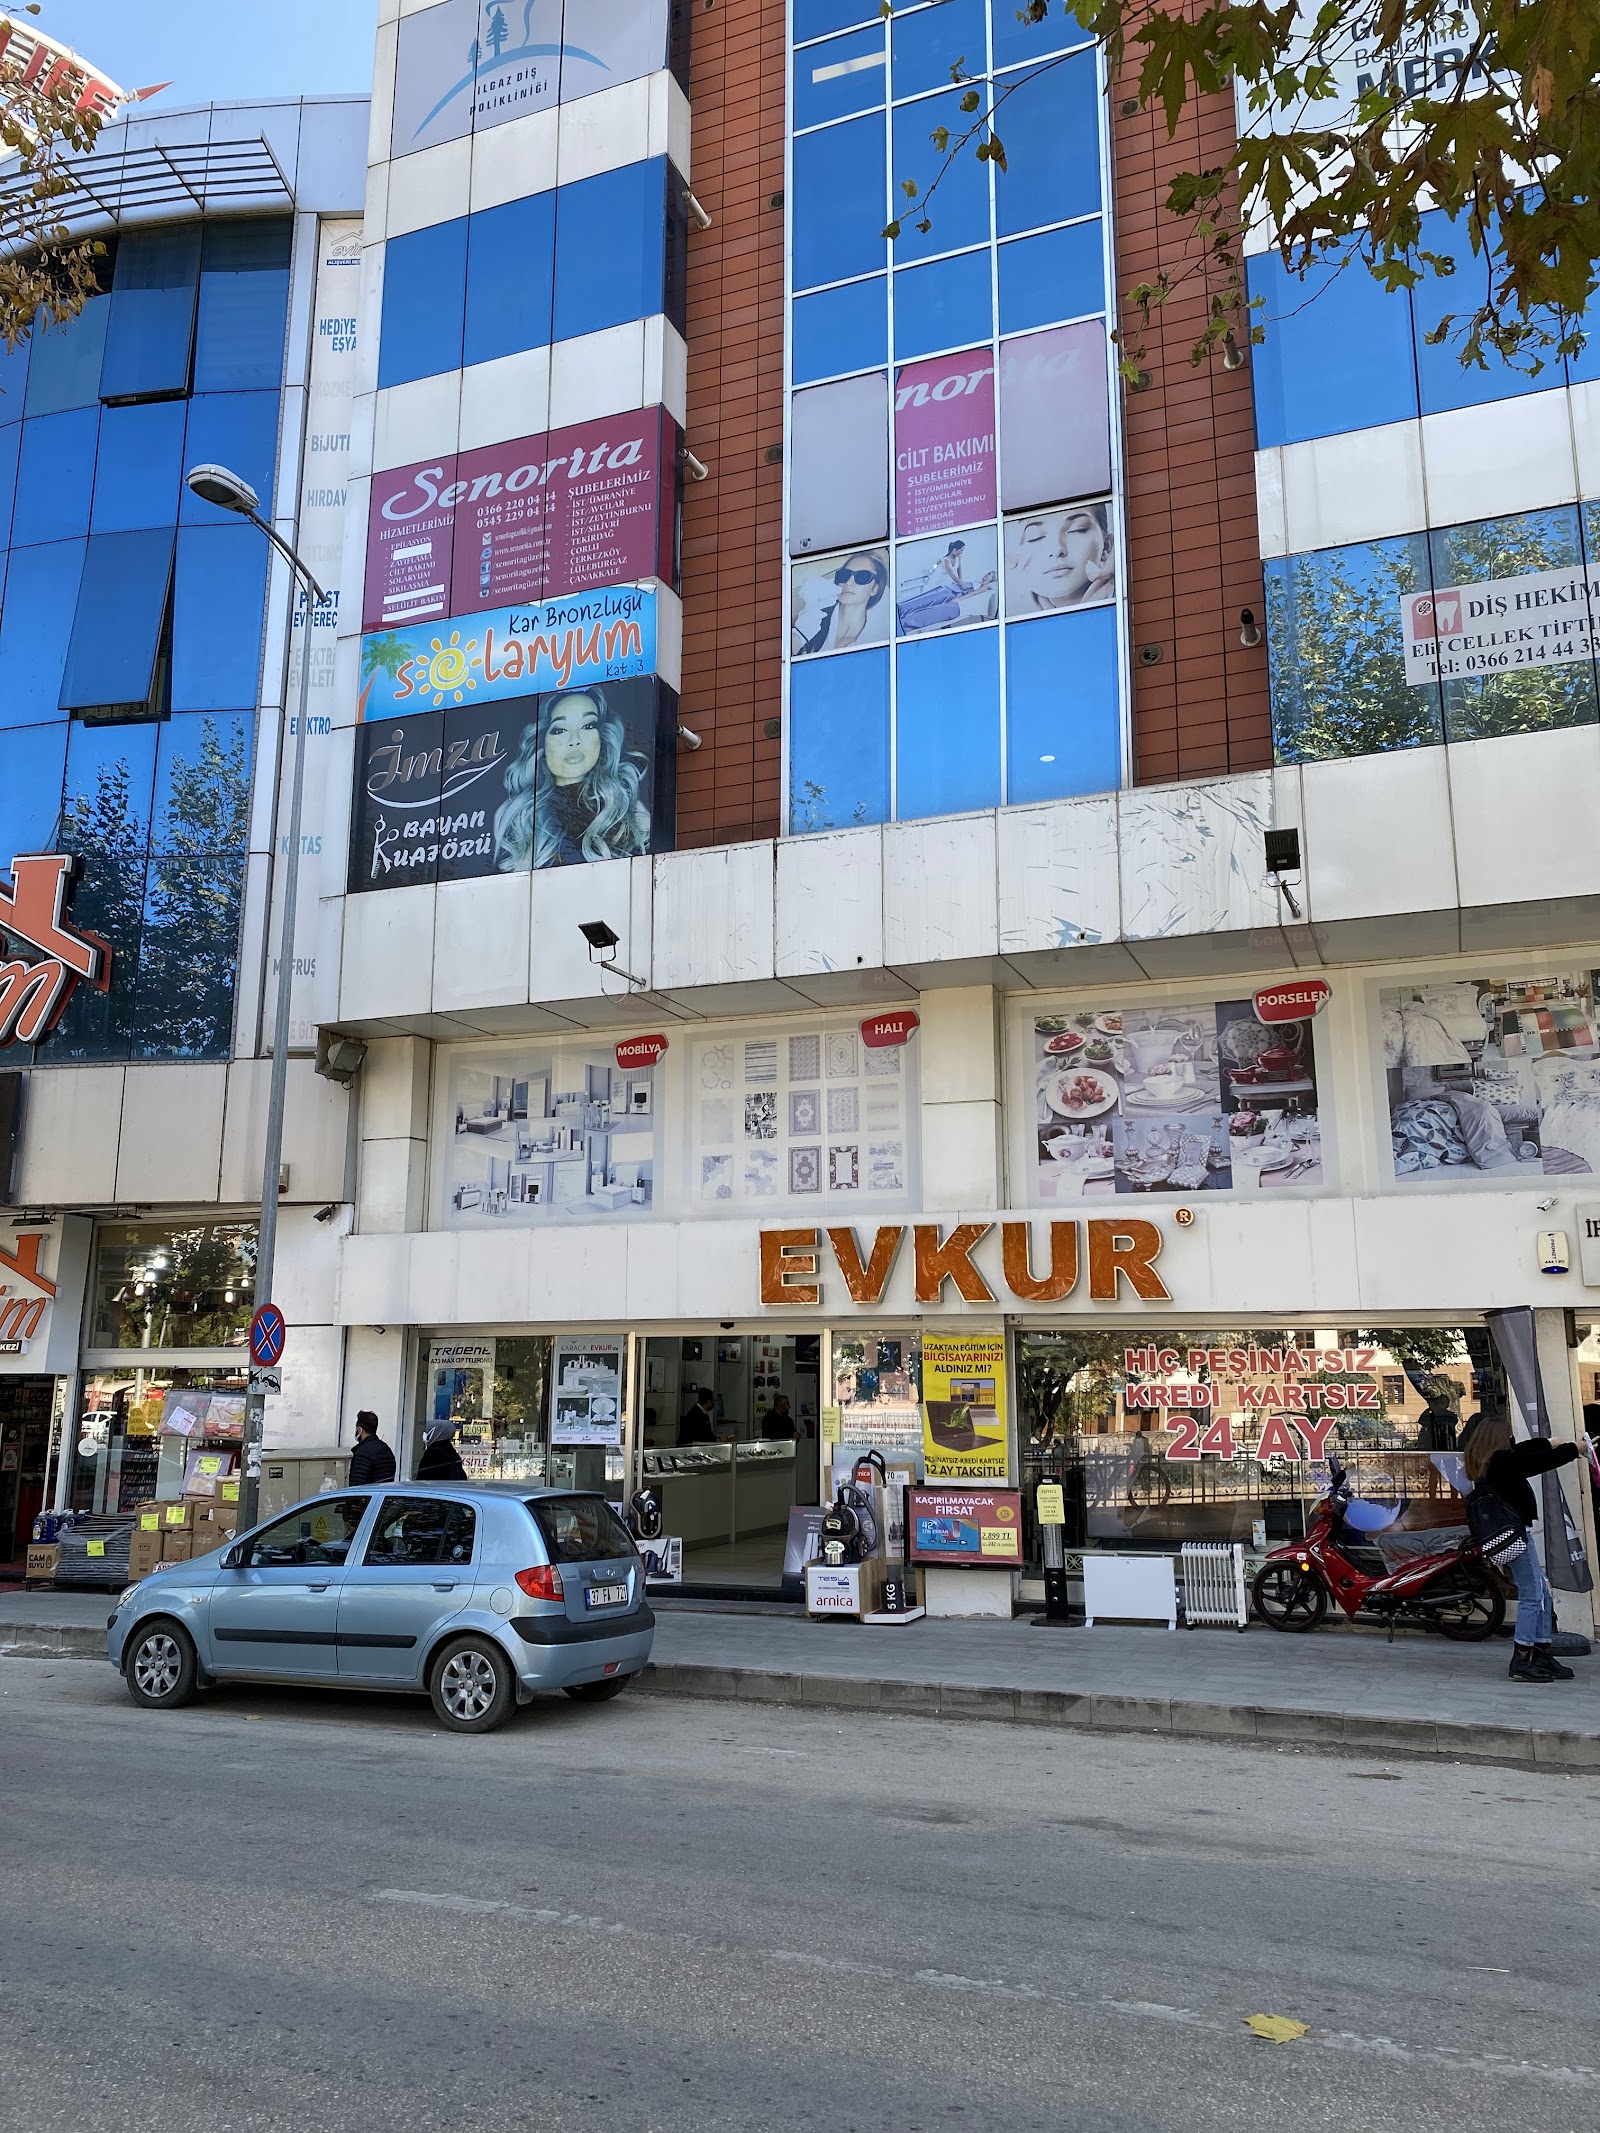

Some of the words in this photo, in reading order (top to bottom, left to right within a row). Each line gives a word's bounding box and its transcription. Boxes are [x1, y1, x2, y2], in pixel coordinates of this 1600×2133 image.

[477, 75, 512, 95] ILGAZ
[517, 67, 537, 82] DİŞ
[469, 79, 547, 116] POLİKLİNİĞİ
[897, 445, 929, 472] CİLT
[932, 433, 994, 464] BAKIMI
[381, 438, 645, 521] Senorita
[907, 461, 984, 488] ŞUBELERİMİZ
[568, 470, 651, 500] ŞUBELERİMİZ
[914, 478, 973, 496] İST/ÜMRANİYE
[477, 504, 503, 517] 0366
[505, 498, 525, 511] 220
[527, 494, 541, 506] 04
[544, 490, 557, 502] 34
[572, 487, 636, 508] İST/ÜMRANİYE
[914, 489, 962, 505] İST/AVCILAR
[914, 494, 986, 515] İST/ZEYTİNBURNU
[476, 514, 502, 529] 0545
[504, 509, 524, 522] 229
[526, 506, 540, 517] 04
[543, 502, 556, 514] 34
[571, 503, 652, 527] İST/ZEYTİNBURNU
[572, 499, 625, 517] İST/AVCILAR
[916, 508, 954, 524] TEKİRDAĞ
[380, 513, 455, 542] HİZMETLERİMİZ
[571, 518, 620, 537] İST/SİLİVRİ
[390, 536, 432, 551] EPİLASYON
[570, 529, 614, 546] TEKİRDAĞ
[570, 543, 599, 557] ÇORLU
[570, 547, 621, 566] ÇERKEZKÖY
[388, 566, 406, 577] CİLT
[407, 560, 436, 573] BAKIMI
[388, 570, 431, 586] SOLARYUM
[569, 567, 621, 585] ÇANAKKALE
[387, 579, 430, 595] SIKILAŞMA
[299, 590, 340, 609] PAST
[387, 599, 419, 612] SELÜLİT
[1468, 594, 1508, 618] DİŞ
[508, 613, 540, 636] Kar
[546, 594, 643, 628] Bronzluğu
[1412, 640, 1444, 658] Elif
[1447, 627, 1534, 653] CELLEK
[295, 647, 336, 667] EEKTRİ
[1427, 659, 1461, 676] Tel:
[1466, 650, 1509, 671] 0366
[1514, 644, 1546, 664] 214
[1552, 640, 1574, 657] 44
[289, 716, 331, 736] EKTRO
[366, 728, 505, 792] İmza
[403, 810, 486, 839] BAYAN
[281, 835, 322, 855] KTAS
[273, 958, 316, 978] MFRUŞ
[1257, 988, 1330, 1007] PORSELEN
[874, 1021, 904, 1035] HALI
[617, 1042, 661, 1057] MOBİLYA
[759, 1217, 1175, 1305] EVKUR
[923, 1343, 959, 1351] UZAKTAN
[960, 1342, 987, 1352] EĞİTİM
[987, 1341, 1004, 1352] İÇİN
[923, 1350, 1004, 1362] BİLGİSAYARINIZI
[934, 1364, 973, 1373] ALDINIZ
[974, 1364, 992, 1373] MI?
[1125, 1342, 1179, 1377] HİÇ
[1187, 1342, 1380, 1379] PEŞİNATSIZ
[1125, 1379, 1222, 1409] KREDİ
[1235, 1382, 1382, 1410] KARTSIZ
[464, 1425, 487, 1434] 2.099
[1165, 1415, 1238, 1462] 24
[1255, 1415, 1338, 1462] AY
[925, 1464, 938, 1475] 12
[939, 1465, 954, 1476] AY
[955, 1464, 1005, 1477] TAKSİTLE
[980, 1457, 1005, 1465] KARTSIZ
[857, 1469, 871, 1477] nica
[915, 1496, 995, 1506] KAÇIRILMAYACAK
[935, 1505, 975, 1516] FIRSAT
[981, 1532, 1001, 1541] 2.899
[1002, 1531, 1012, 1541] TL
[28, 1554, 46, 1562] CAM
[591, 1590, 599, 1604] 37
[603, 1588, 611, 1602] FA
[616, 1584, 627, 1600] 721
[816, 1594, 853, 1607] arnica
[886, 1583, 896, 1601] KG
